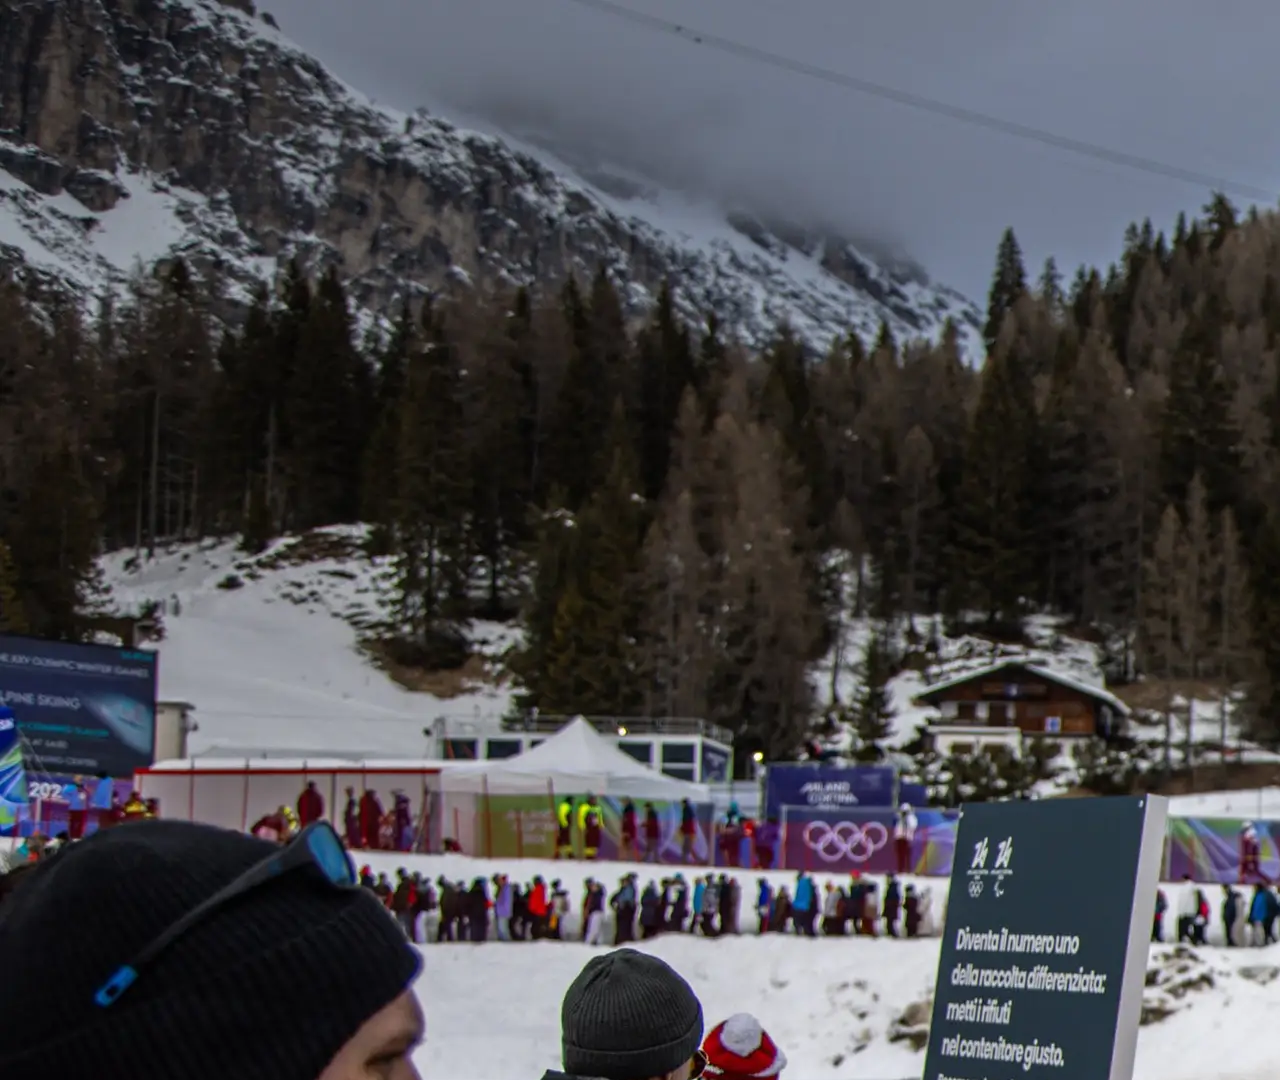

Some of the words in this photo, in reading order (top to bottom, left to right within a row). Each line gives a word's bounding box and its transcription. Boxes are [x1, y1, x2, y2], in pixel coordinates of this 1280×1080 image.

[29, 781, 63, 799] 202
[956, 926, 998, 951] Diventa
[999, 927, 1009, 951] il
[1009, 933, 1054, 954] numero
[1055, 935, 1080, 954] uno
[952, 963, 978, 986] della
[979, 965, 1025, 989] raccolta
[1027, 964, 1107, 994] differenziata:
[946, 998, 977, 1022] metti
[982, 998, 1012, 1025] rifiuti
[941, 1034, 960, 1056] nel
[959, 1036, 1023, 1064] contenitore
[1024, 1038, 1065, 1071] giusto.
